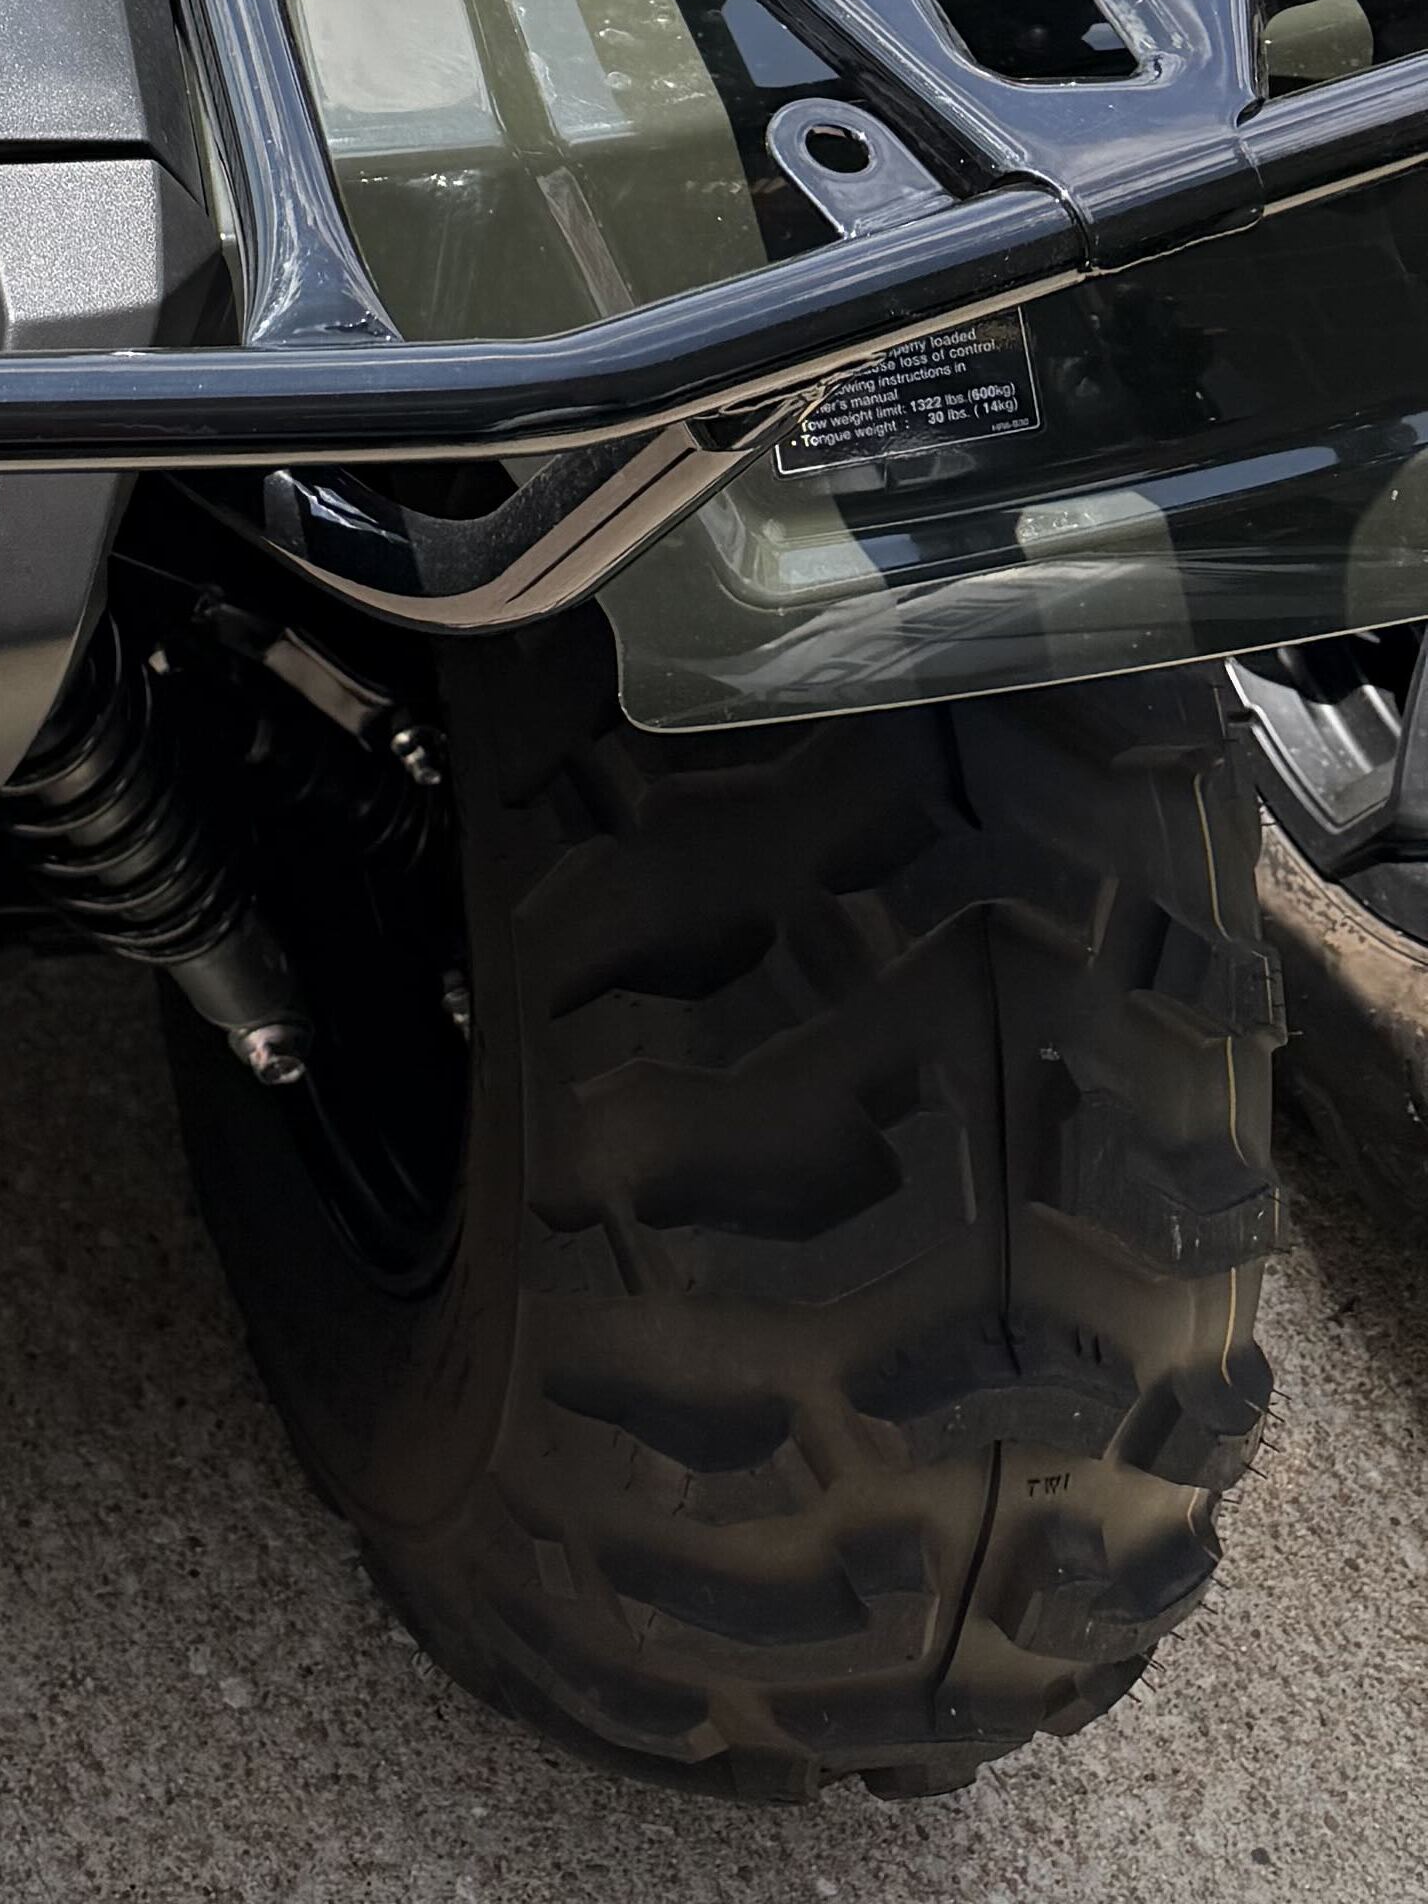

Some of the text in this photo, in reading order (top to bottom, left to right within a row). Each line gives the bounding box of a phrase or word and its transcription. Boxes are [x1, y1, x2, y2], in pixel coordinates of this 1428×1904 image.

[930, 328, 977, 349] loaded
[900, 355, 928, 367] loss
[932, 348, 945, 361] of
[878, 364, 951, 388] instructions
[954, 362, 967, 374] in
[851, 389, 899, 408] manual
[831, 410, 874, 428] weight
[876, 405, 908, 418] limit:
[910, 396, 942, 412] 1322
[800, 432, 851, 447] Tongue
[855, 423, 897, 439] weight
[928, 412, 944, 424] 30
[947, 408, 970, 422] lbs.
